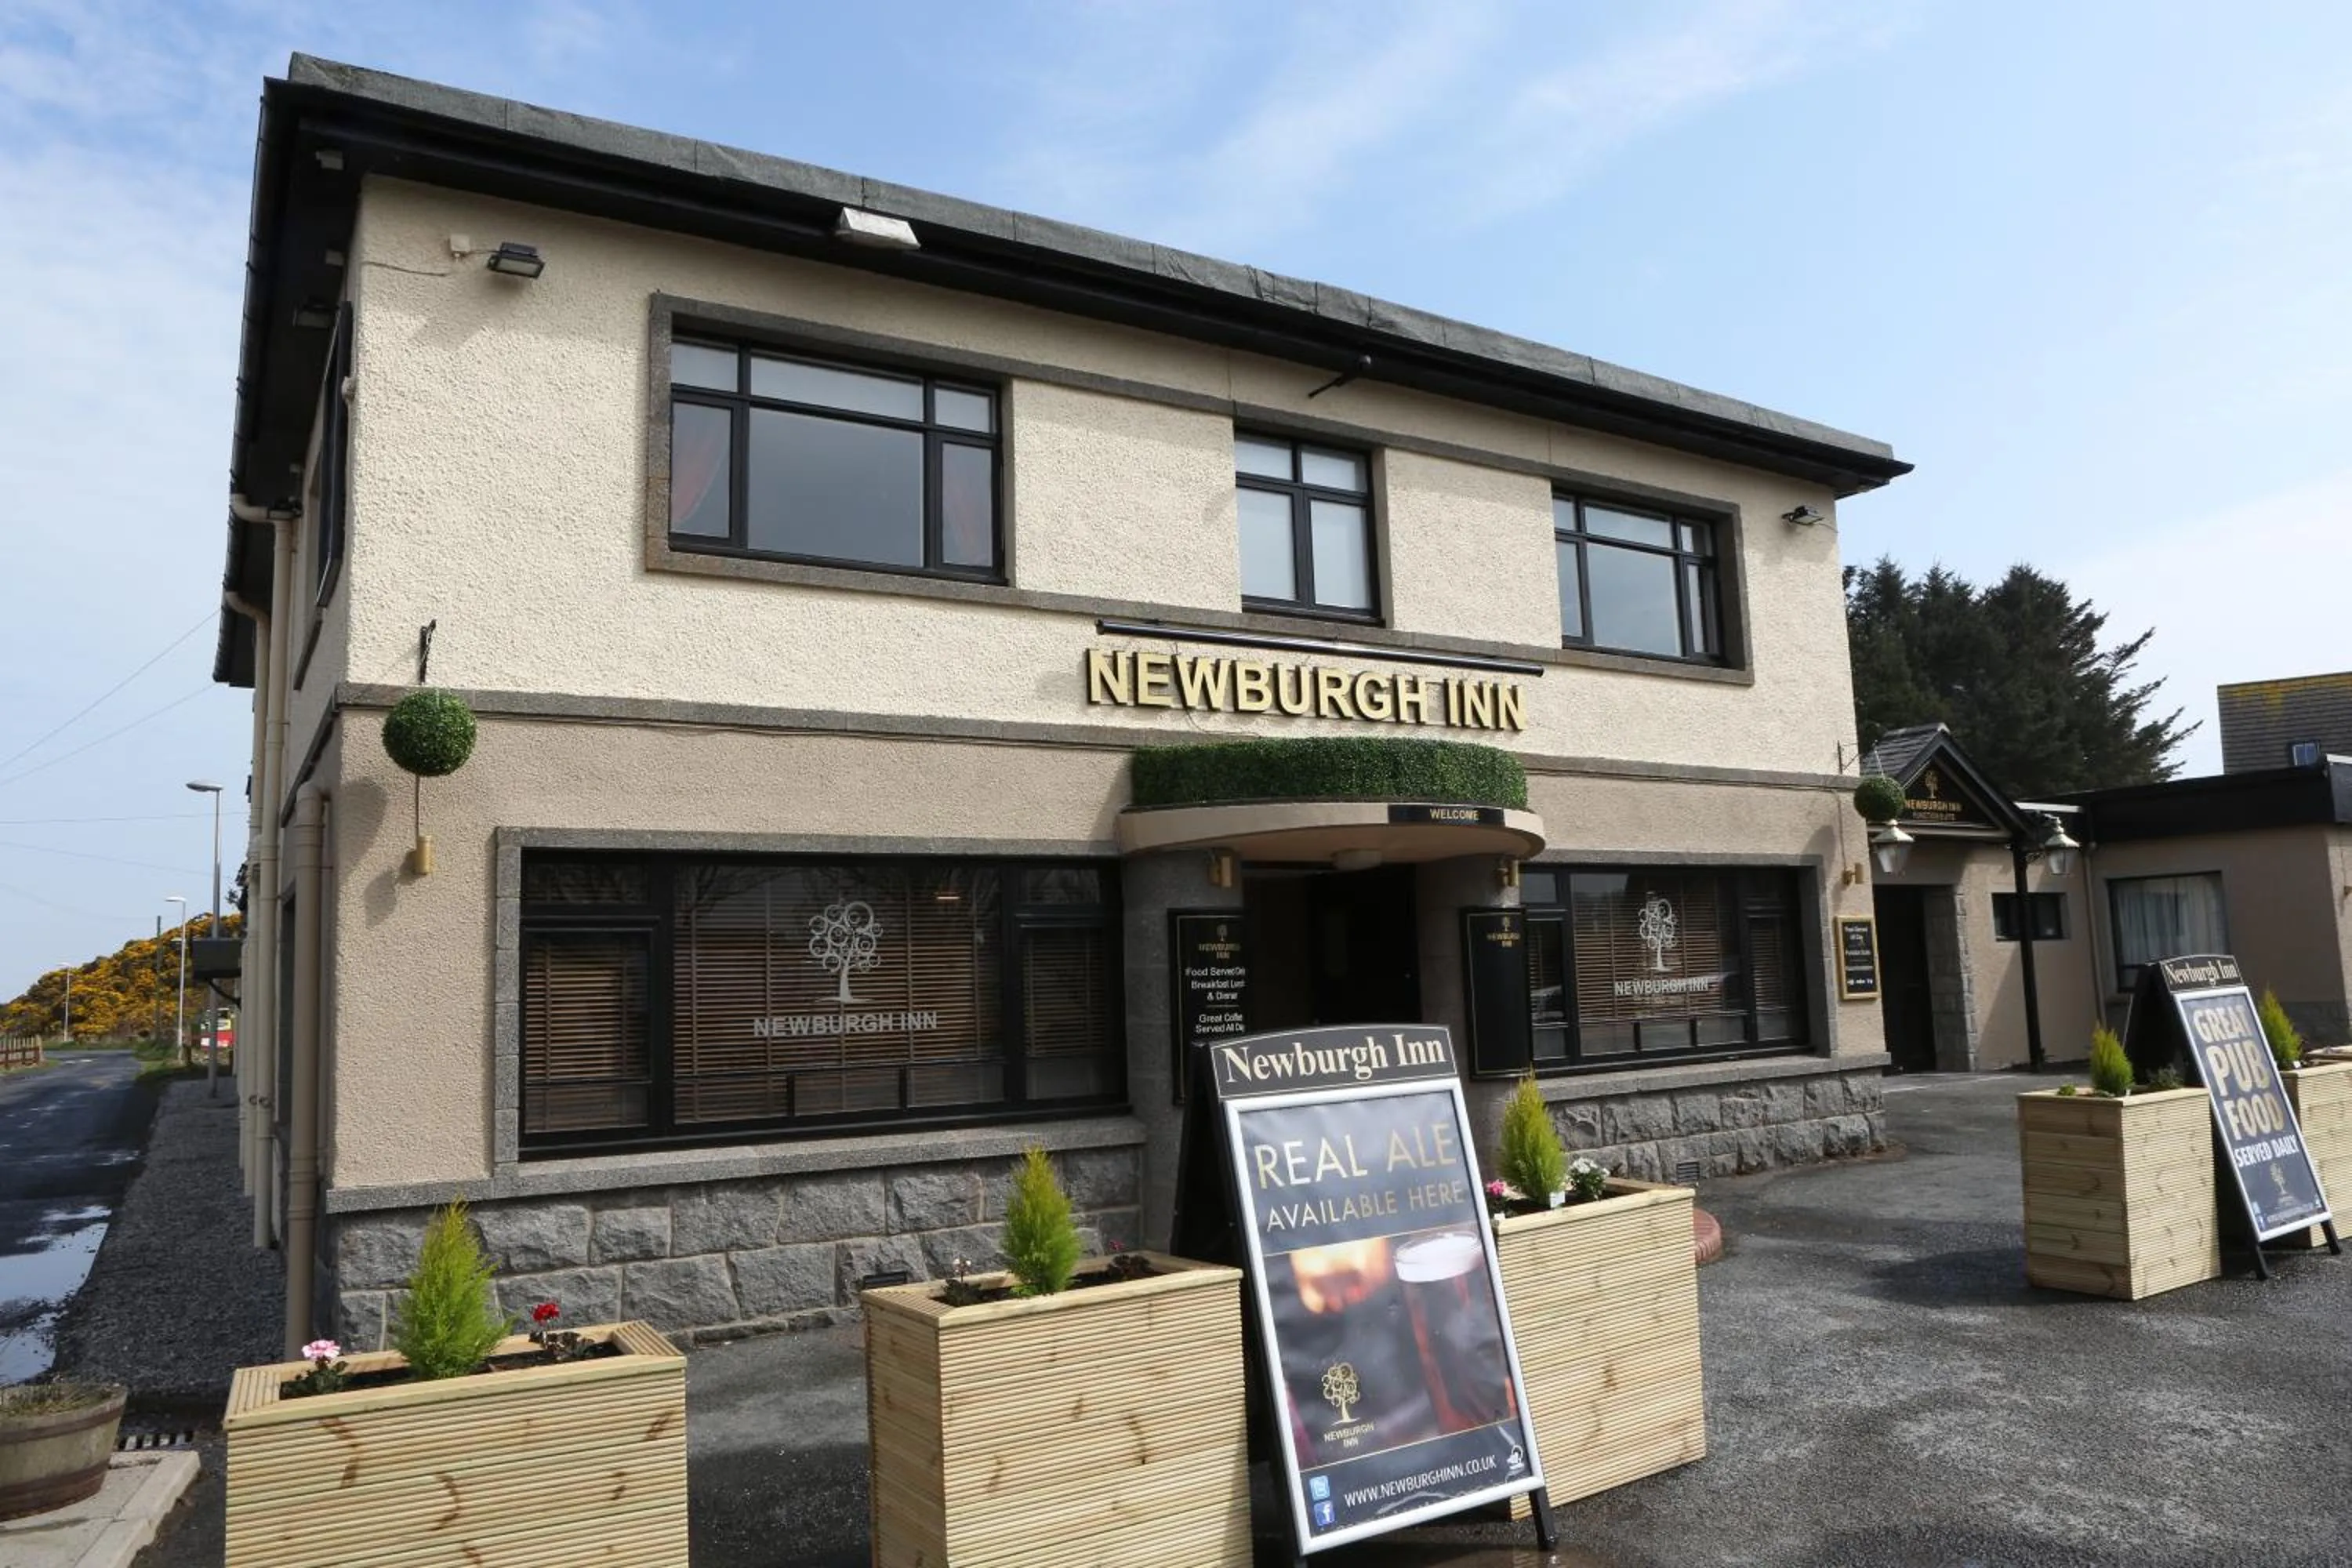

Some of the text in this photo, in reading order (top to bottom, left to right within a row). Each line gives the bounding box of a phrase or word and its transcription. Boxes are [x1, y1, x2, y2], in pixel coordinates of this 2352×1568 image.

[1087, 648, 1526, 730] NEWBURGH INN
[1430, 808, 1480, 821] WELCOME
[1185, 967, 1207, 976] Food
[2166, 959, 2238, 985] Newburgh Inn
[1207, 992, 1214, 1001] &
[1614, 978, 1708, 996] NEWBURGH INN
[753, 1011, 938, 1037] NEWBURGH INN
[1196, 1024, 1225, 1033] Served
[1225, 1023, 1235, 1032] All
[1199, 1014, 1222, 1023] Great
[2193, 1006, 2252, 1043] GREAT
[1221, 1033, 1446, 1083] Newburgh Inn
[2205, 1041, 2270, 1097] PUB
[2223, 1092, 2285, 1141] FOOD
[1254, 1123, 1457, 1189] REAL ALE
[2235, 1134, 2300, 1167] SERVED DAILY
[1266, 1179, 1466, 1232] AVAILABLE HERE
[1323, 1423, 1374, 1443] NEWBURGH
[1343, 1437, 1359, 1448] INN
[1345, 1454, 1497, 1508] WWW.NEWBURGHINN.CO.UK
